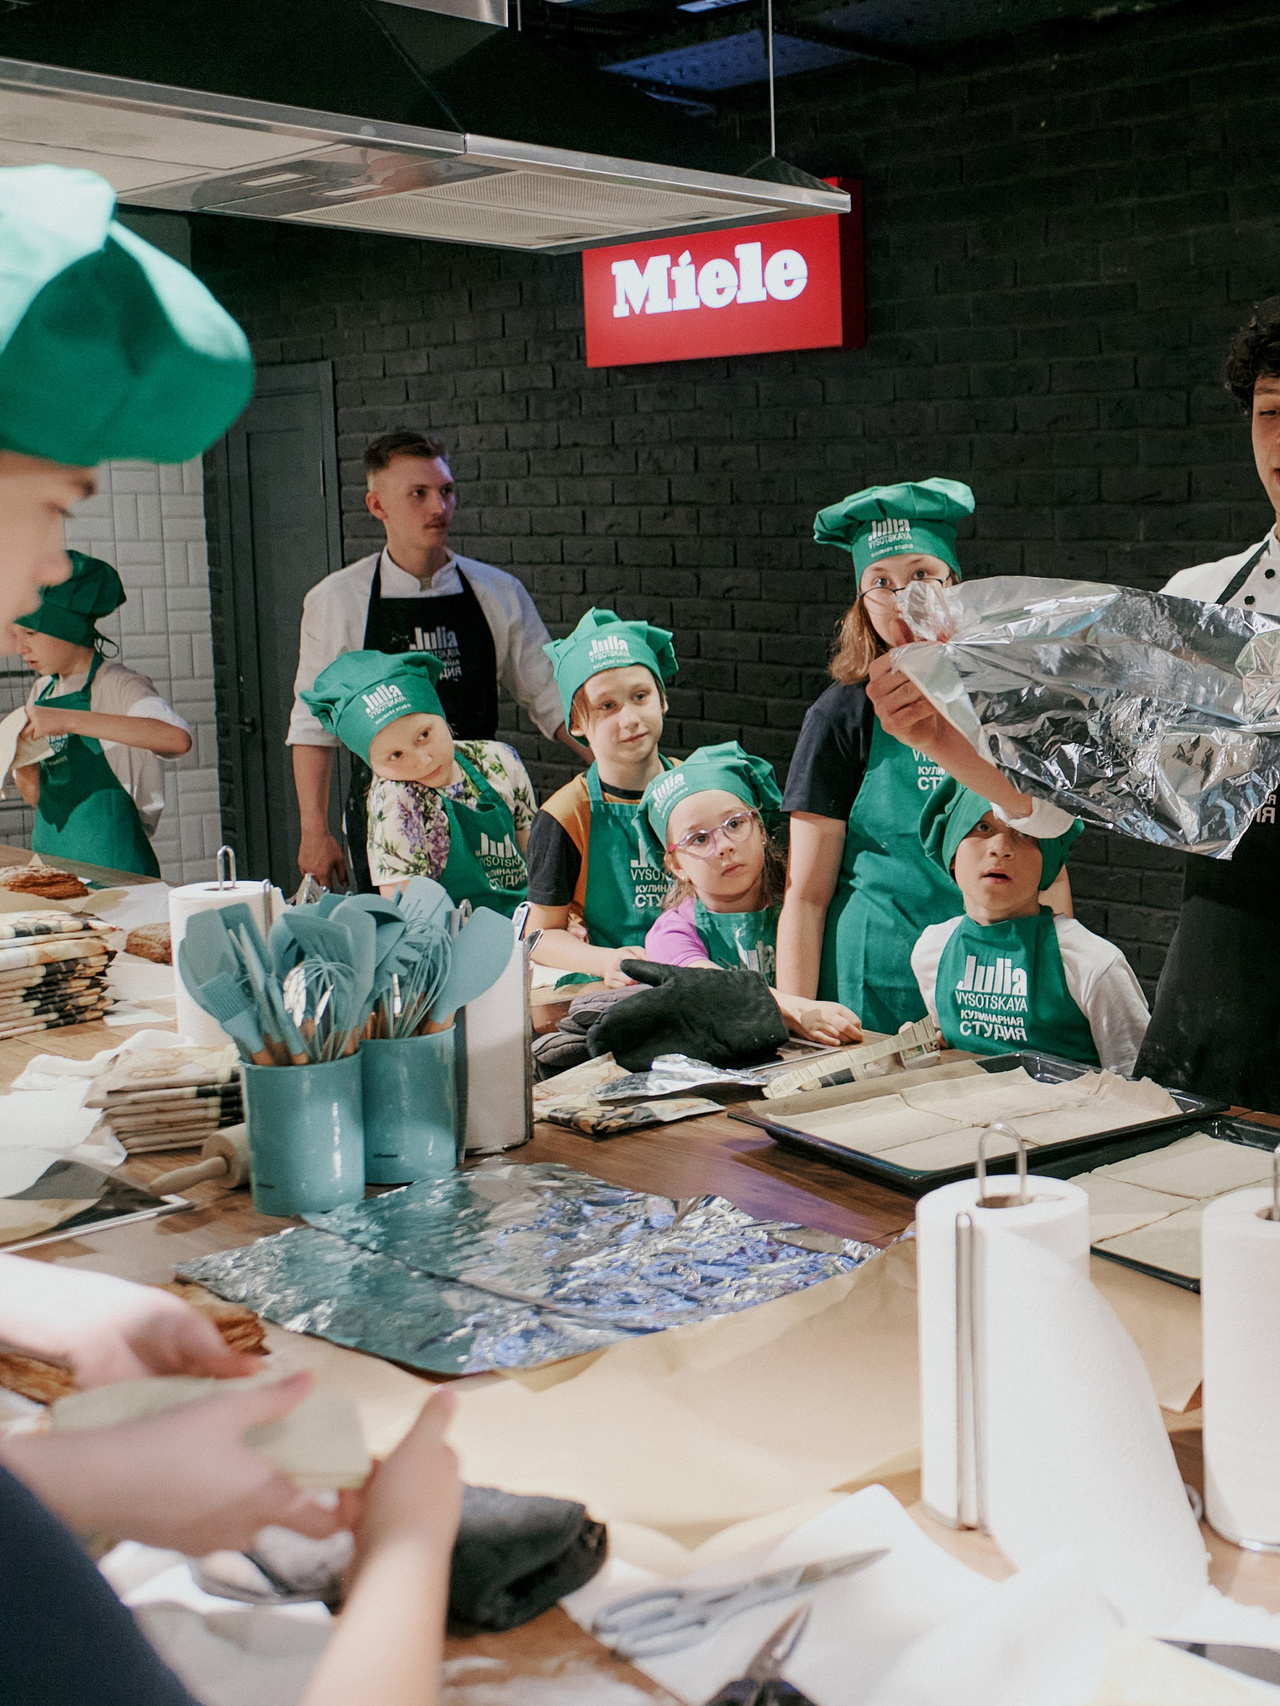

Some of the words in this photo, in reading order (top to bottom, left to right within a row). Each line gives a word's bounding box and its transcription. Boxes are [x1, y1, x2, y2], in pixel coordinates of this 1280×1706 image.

[611, 242, 808, 318] Miele
[868, 518, 911, 541] Julia
[589, 635, 629, 656] Julia
[362, 684, 404, 713] Julia
[634, 893, 664, 908] СТУ
[955, 954, 1028, 997] Julia
[954, 990, 1028, 1012] VYSOTSKAYA
[960, 1009, 1024, 1027] КУЛИНАРНАЯ
[959, 1020, 1027, 1041] СТУДИЯ
